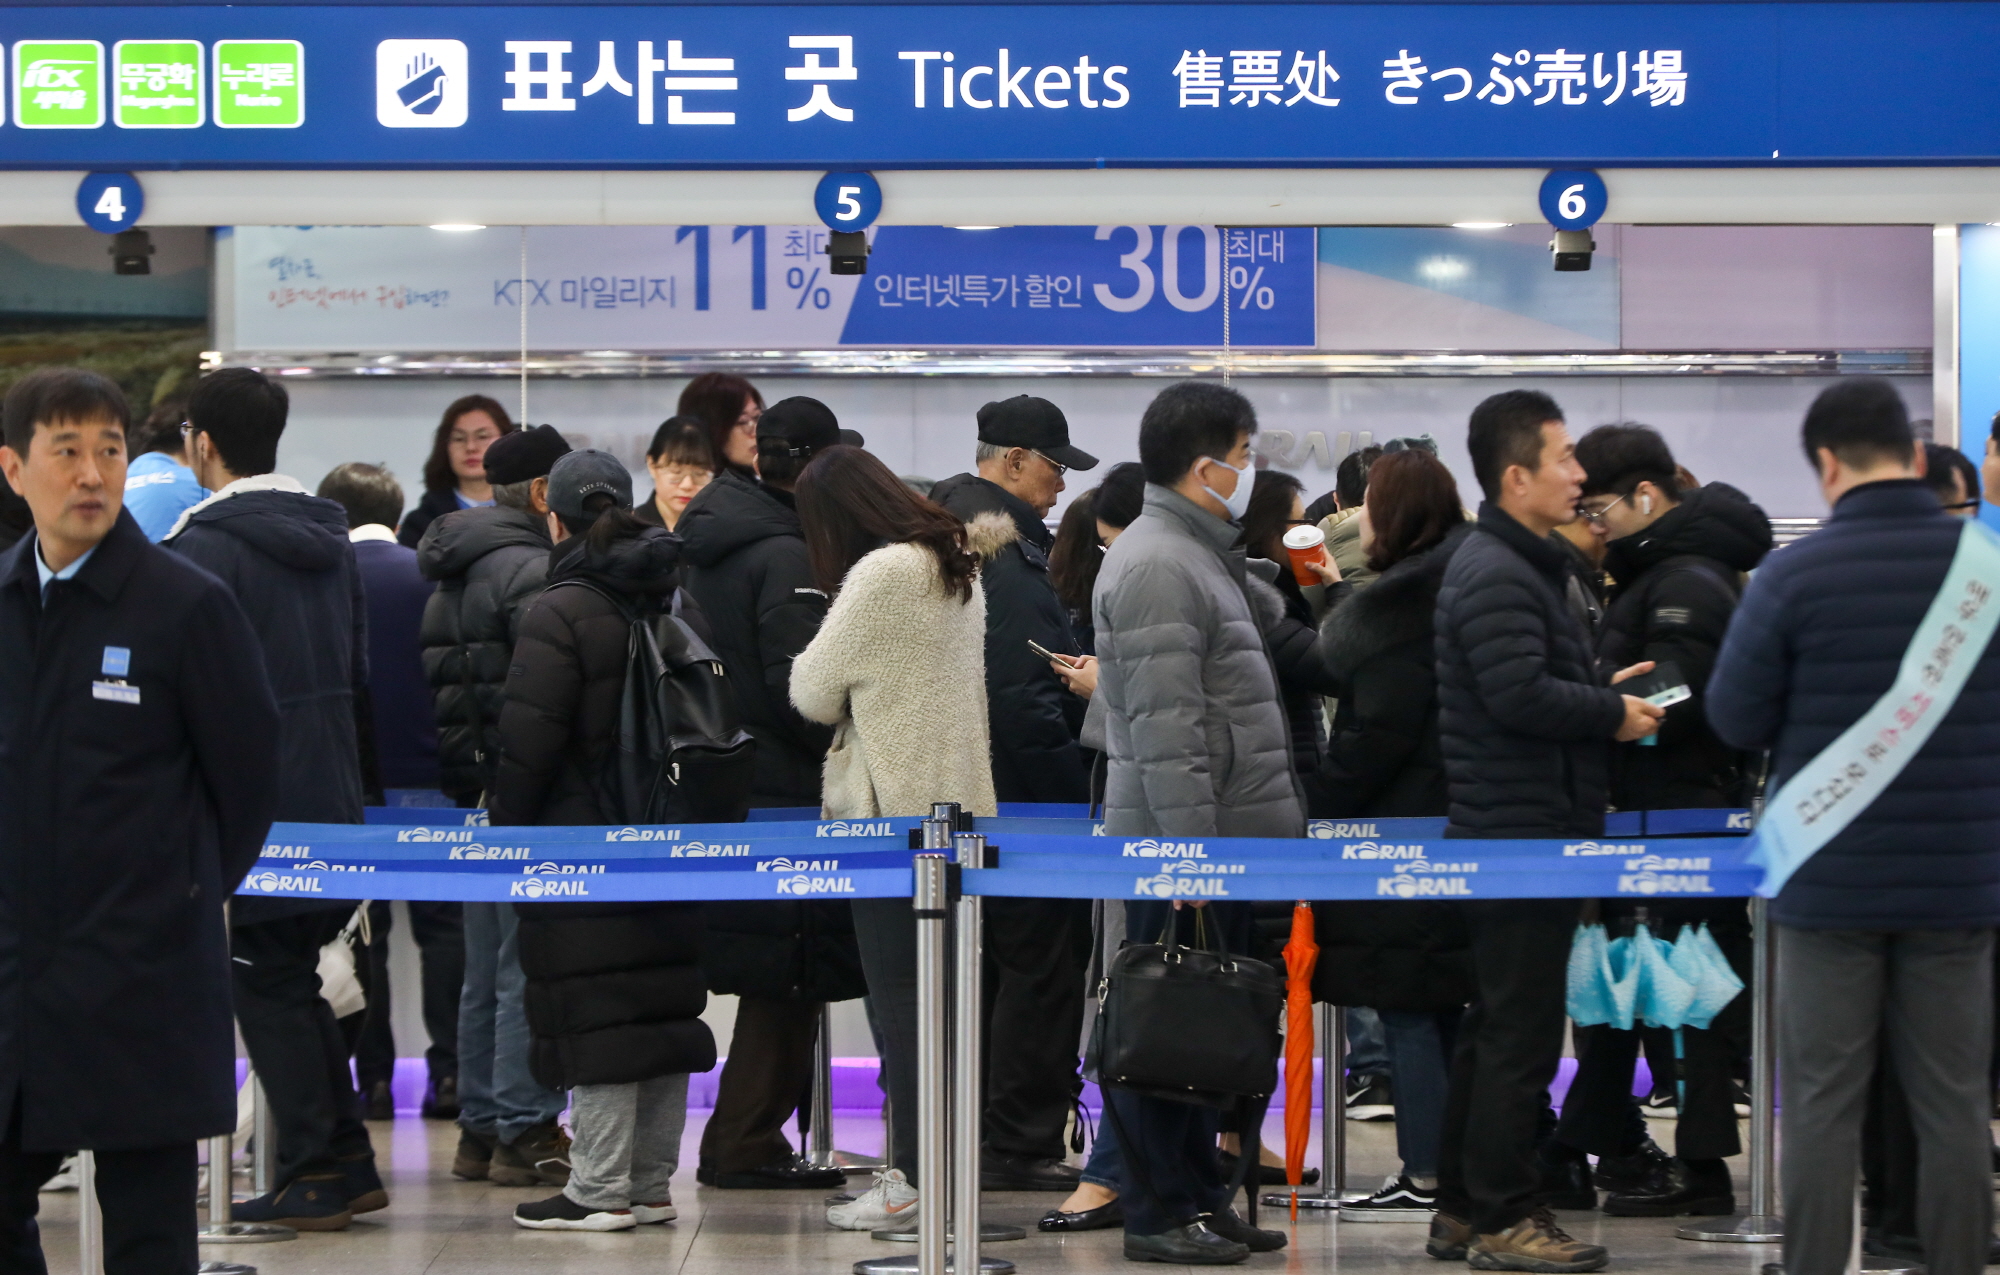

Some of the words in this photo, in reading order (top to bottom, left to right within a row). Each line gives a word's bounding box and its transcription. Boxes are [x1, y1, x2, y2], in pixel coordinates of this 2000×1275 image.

[120, 62, 196, 91] 무궁화
[221, 63, 295, 90] 누리로
[502, 40, 737, 124] 표사는
[784, 36, 858, 122] 곳
[898, 49, 1130, 108] Tickets
[1172, 49, 1341, 109] 售票处
[1382, 49, 1688, 107] きっぷ売り場
[95, 186, 126, 222] 4
[836, 187, 861, 221] 5
[1558, 184, 1587, 220] 6
[1229, 231, 1284, 264] 최대
[494, 279, 552, 306] KTX
[561, 276, 676, 309] 마일리지
[675, 226, 767, 311] 11
[786, 266, 831, 310] %
[874, 274, 1021, 308] 인터넷특가
[1025, 274, 1082, 308] 할인
[1093, 226, 1221, 313] 30
[1229, 266, 1275, 310] %
[816, 821, 895, 838] KORAIL
[259, 845, 313, 859] RAIL
[449, 843, 534, 860] KORAIL
[1123, 839, 1208, 859] KORAIL
[1342, 841, 1428, 860] KORAIL
[245, 872, 323, 893] KORAIL
[510, 878, 589, 899] KORAIL
[776, 874, 855, 896] KORAIL
[1134, 874, 1229, 899] KORAIL
[1377, 874, 1473, 899] KORAIL
[1618, 871, 1715, 895] KORAIL
